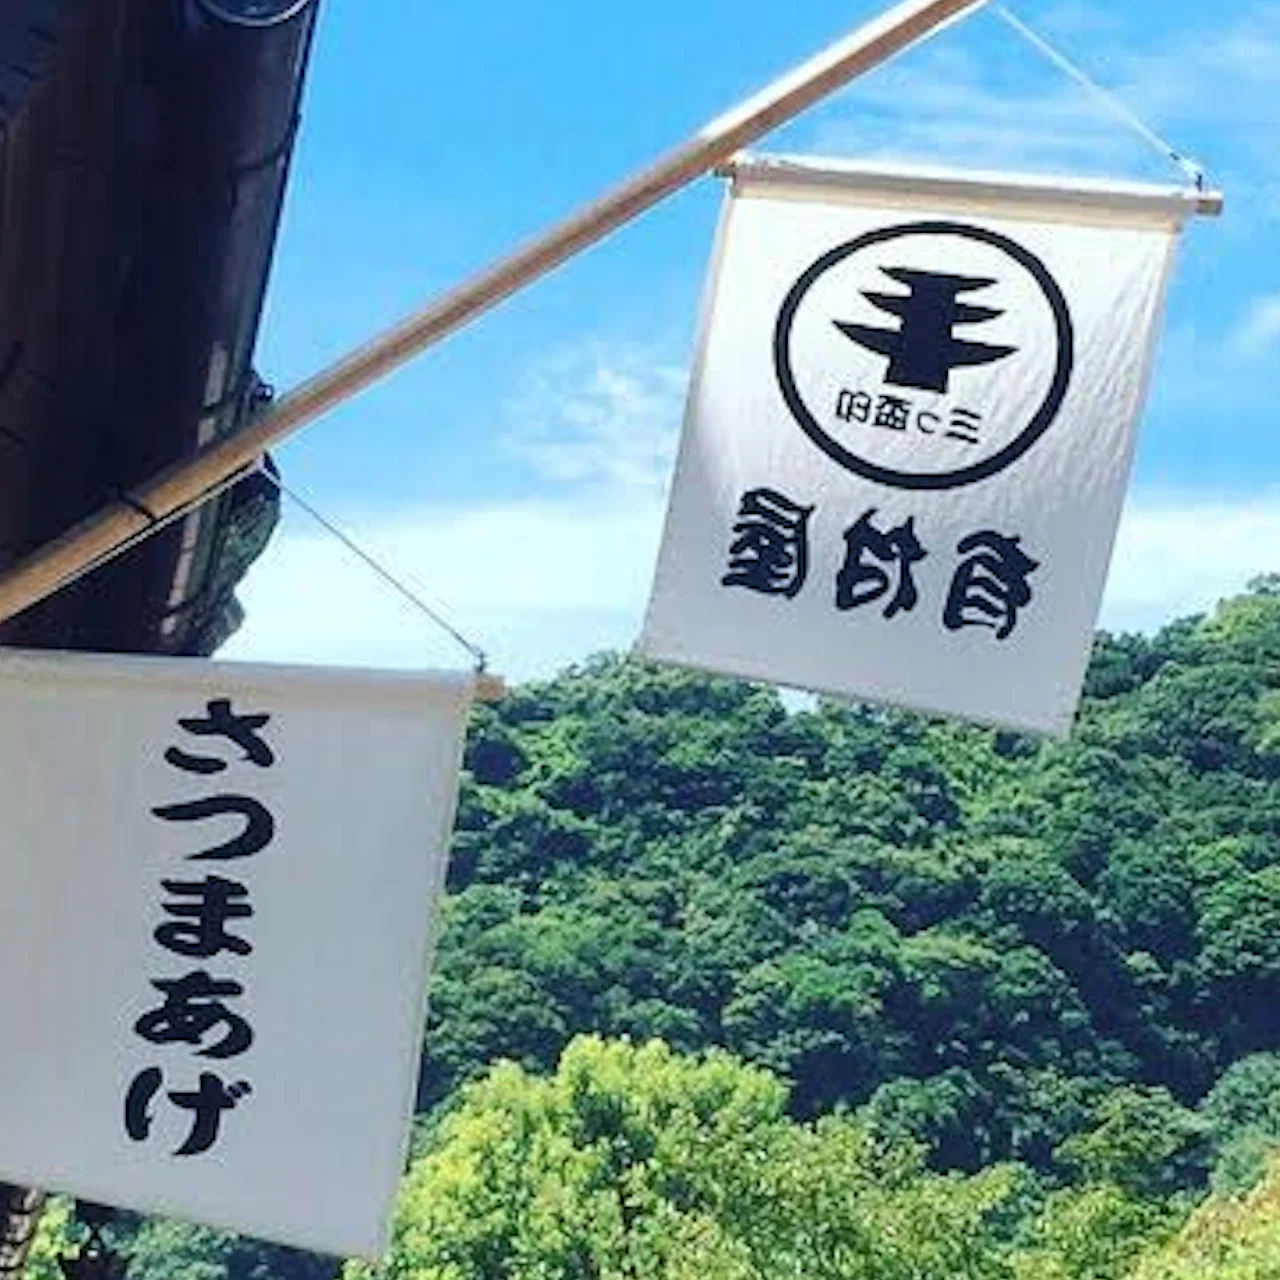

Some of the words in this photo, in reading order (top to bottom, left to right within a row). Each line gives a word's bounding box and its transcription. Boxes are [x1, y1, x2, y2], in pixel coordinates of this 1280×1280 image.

[124, 698, 274, 1156] さつまあげ
